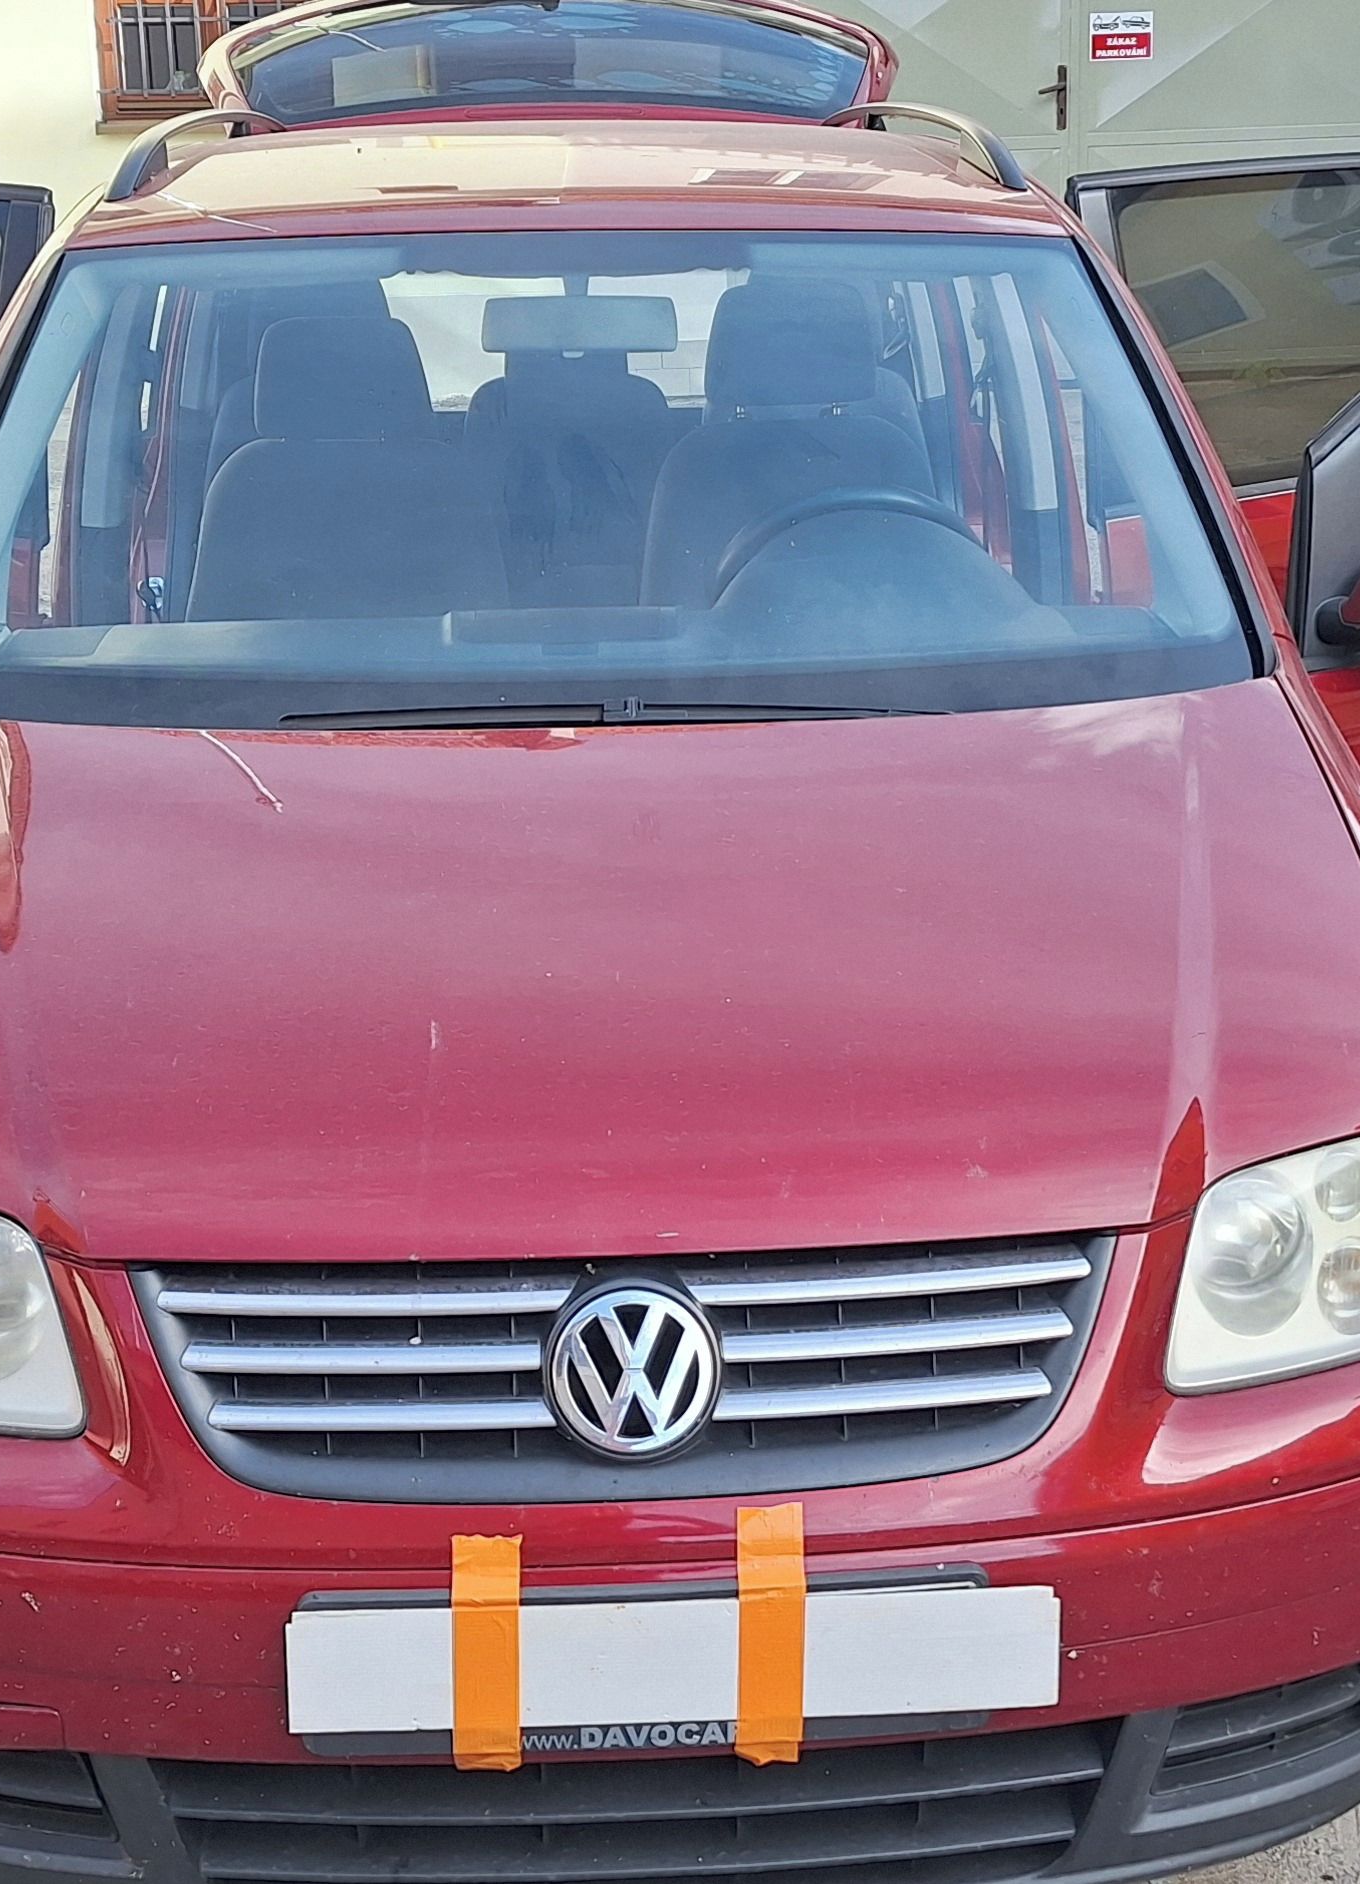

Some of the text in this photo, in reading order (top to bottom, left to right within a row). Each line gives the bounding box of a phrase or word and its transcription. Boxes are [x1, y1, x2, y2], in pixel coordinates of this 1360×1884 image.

[1106, 37, 1137, 46] ZÁKAZ
[1096, 47, 1147, 57] PARKOVÁNÍ
[552, 1289, 715, 1451] VW
